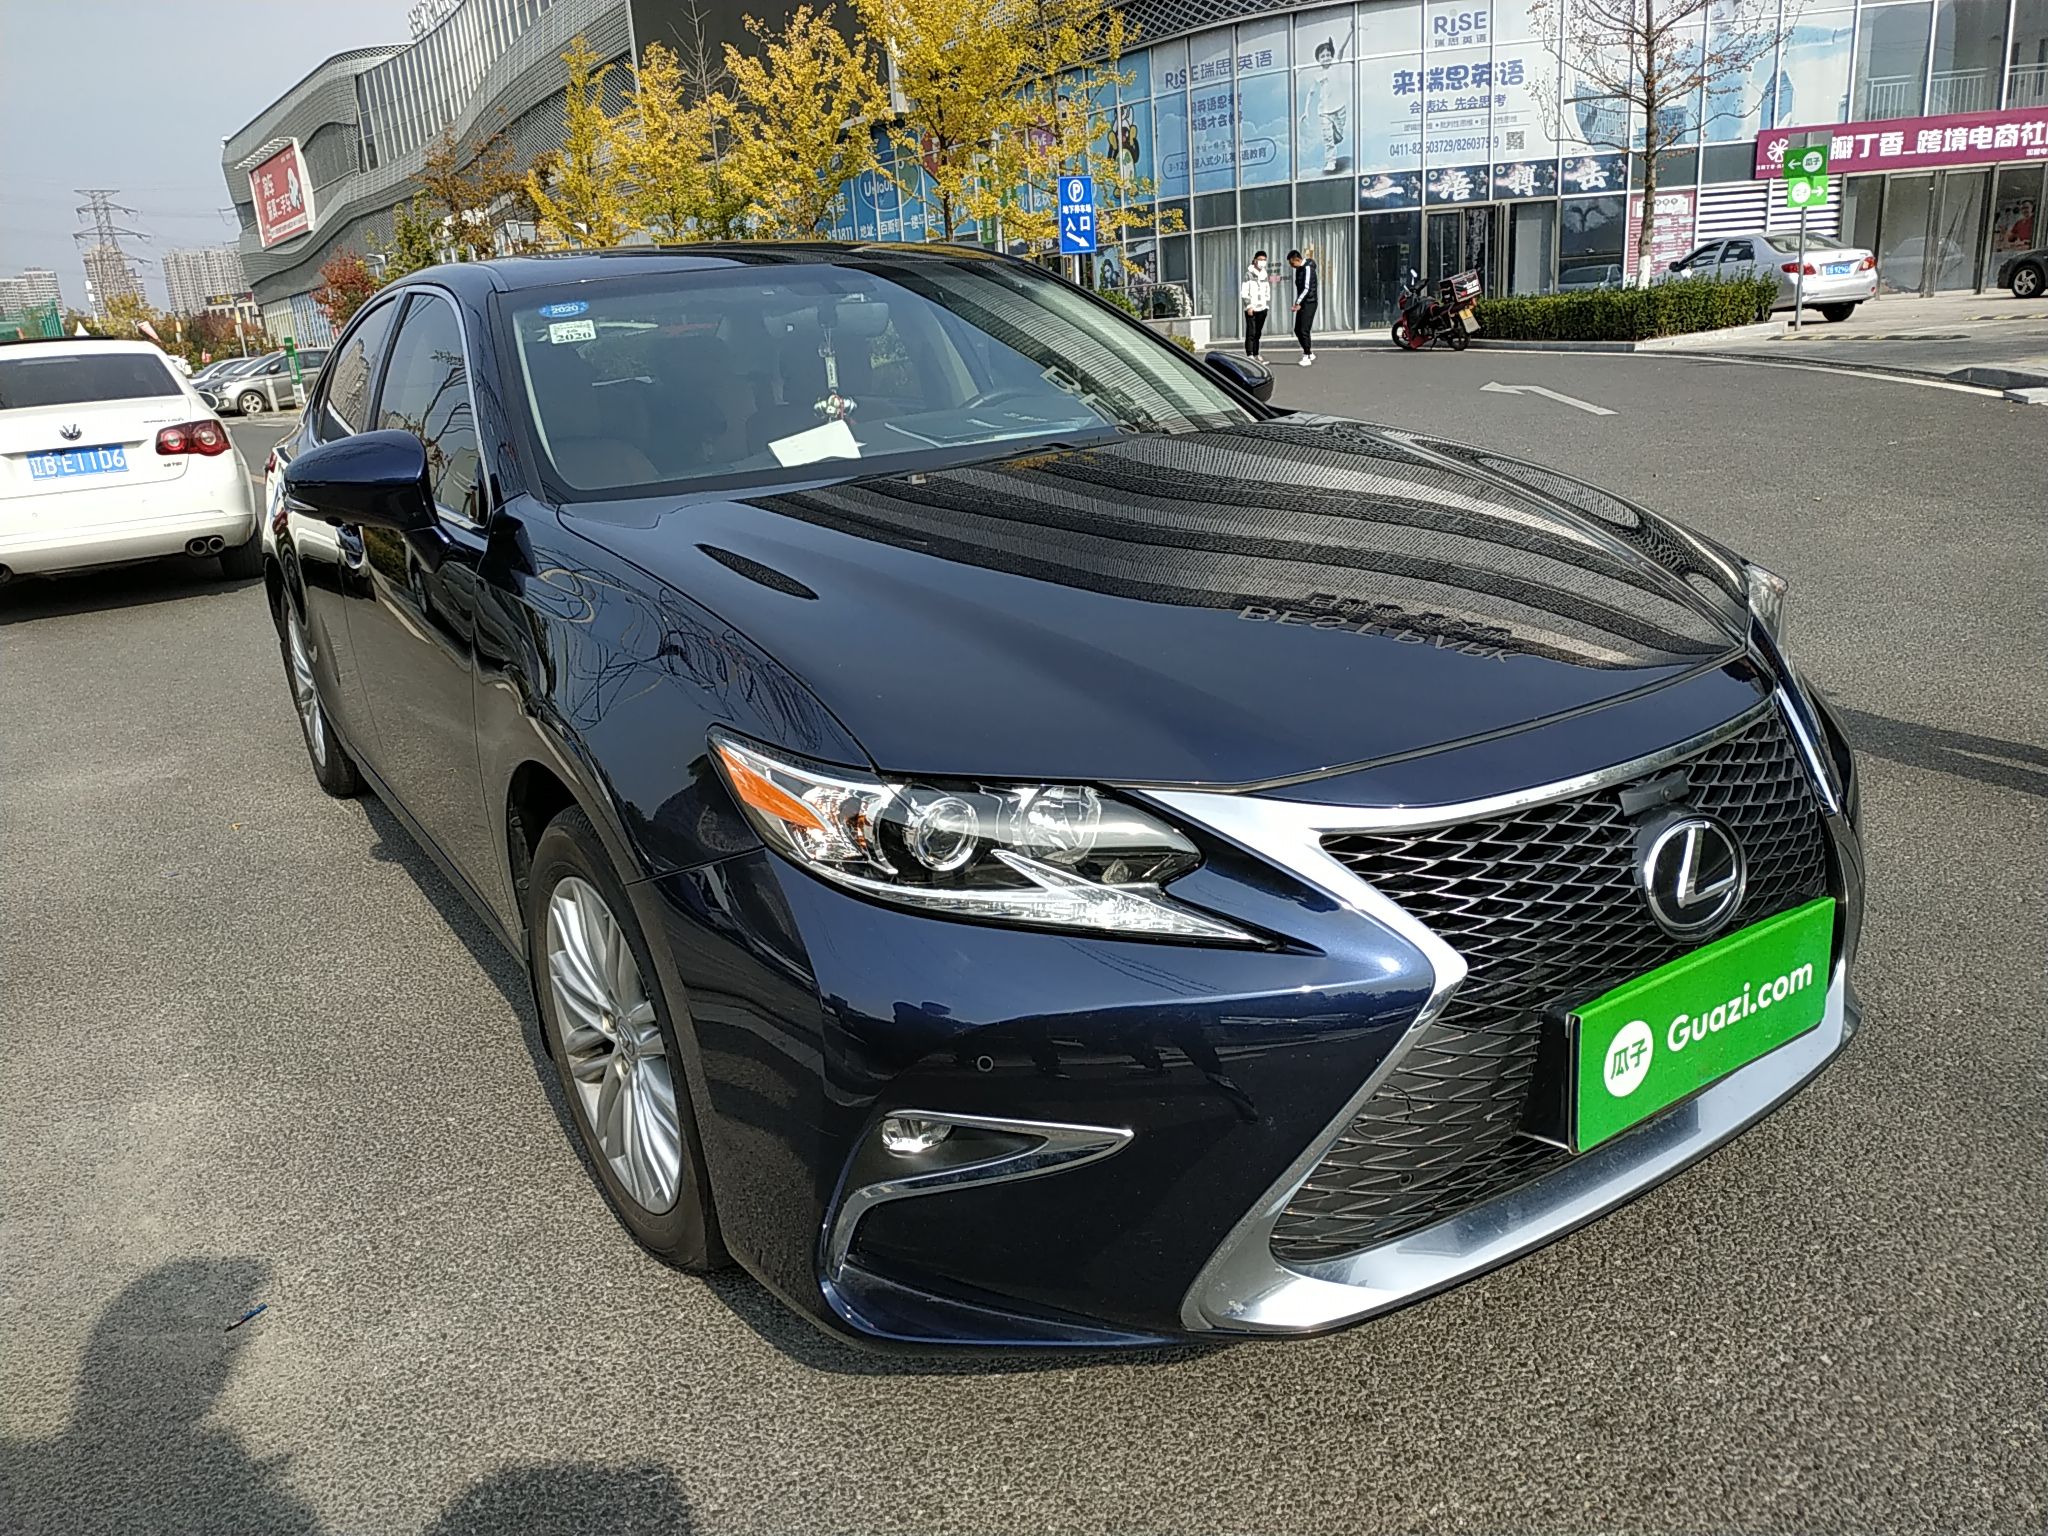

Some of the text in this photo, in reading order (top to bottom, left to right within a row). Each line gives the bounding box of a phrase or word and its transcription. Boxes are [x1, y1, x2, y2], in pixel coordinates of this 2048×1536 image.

[1393, 59, 1525, 96] 来瑞思英语
[1065, 215, 1091, 232] 入口
[551, 304, 579, 314] 2020
[556, 332, 592, 342] 2020
[1666, 962, 1813, 1052] Guazi.com
[1610, 1038, 1648, 1081] 瓜子
